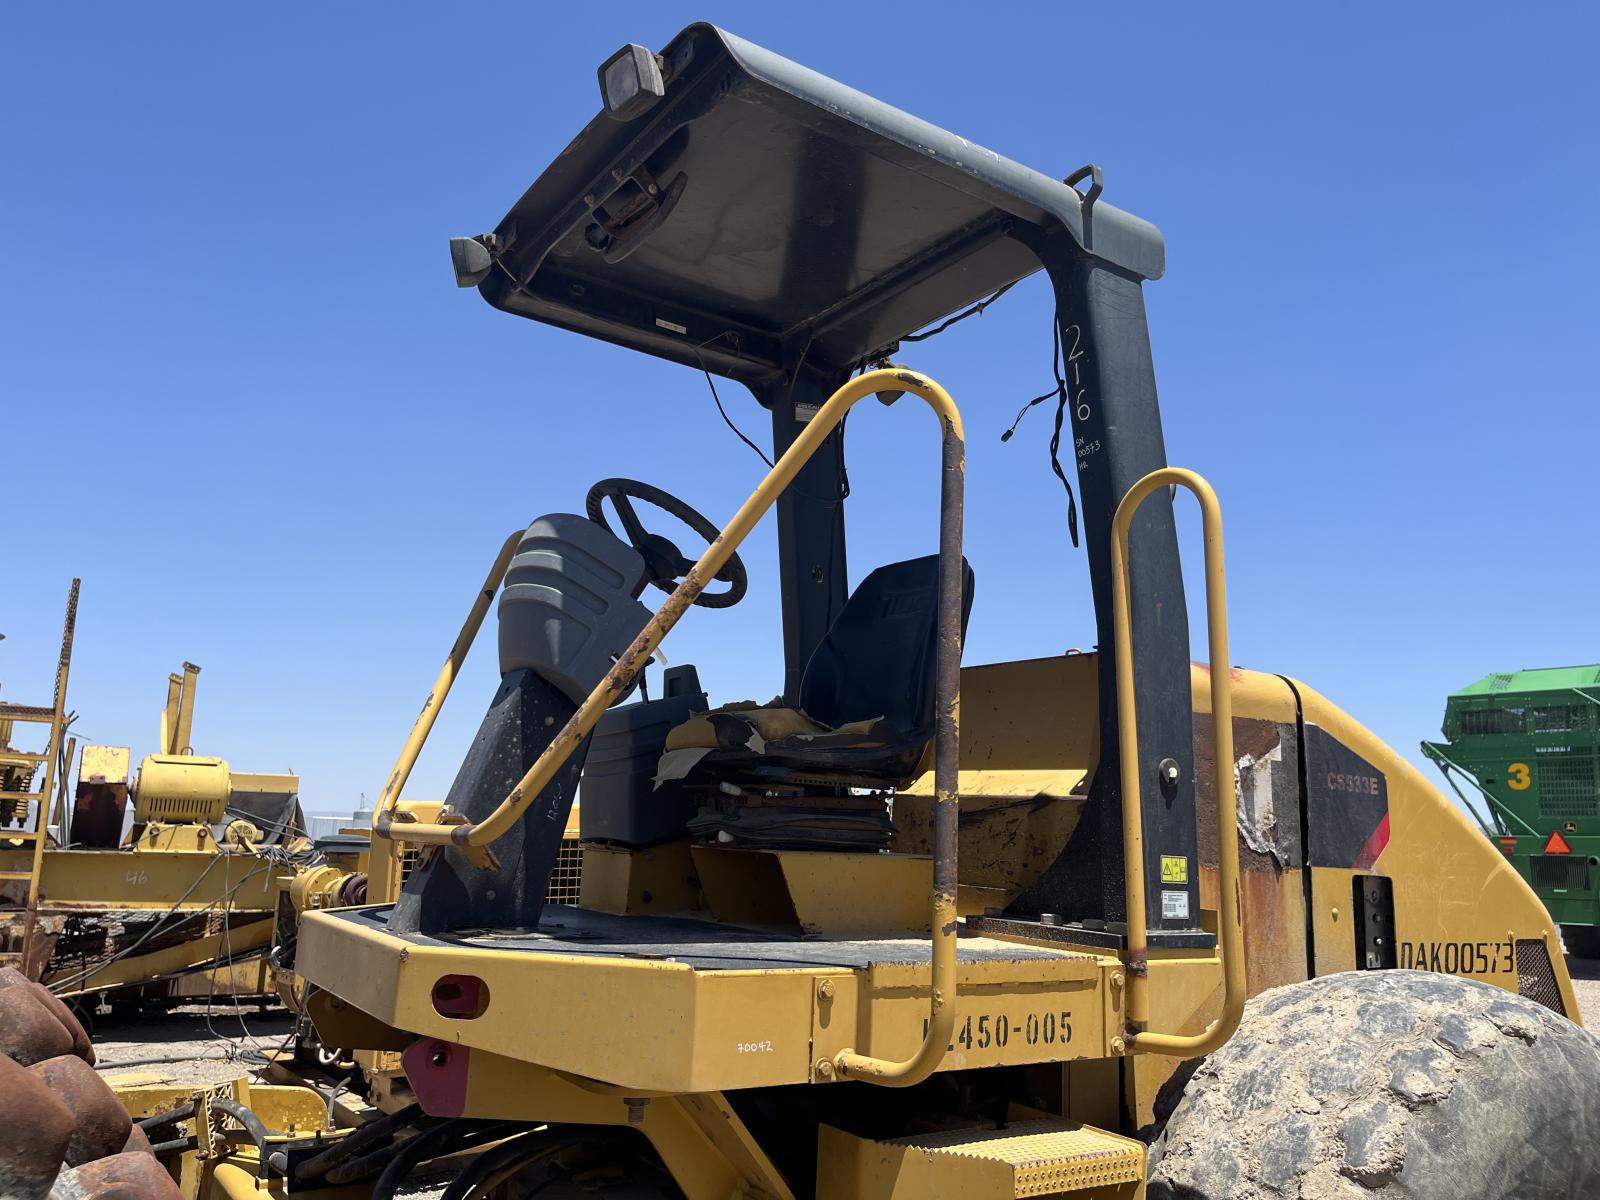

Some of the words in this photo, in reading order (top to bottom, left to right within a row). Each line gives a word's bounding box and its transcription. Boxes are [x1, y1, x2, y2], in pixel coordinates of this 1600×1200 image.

[1507, 762, 1531, 791] 3
[1401, 942, 1514, 974] DAK00573
[737, 1040, 774, 1054] 70042
